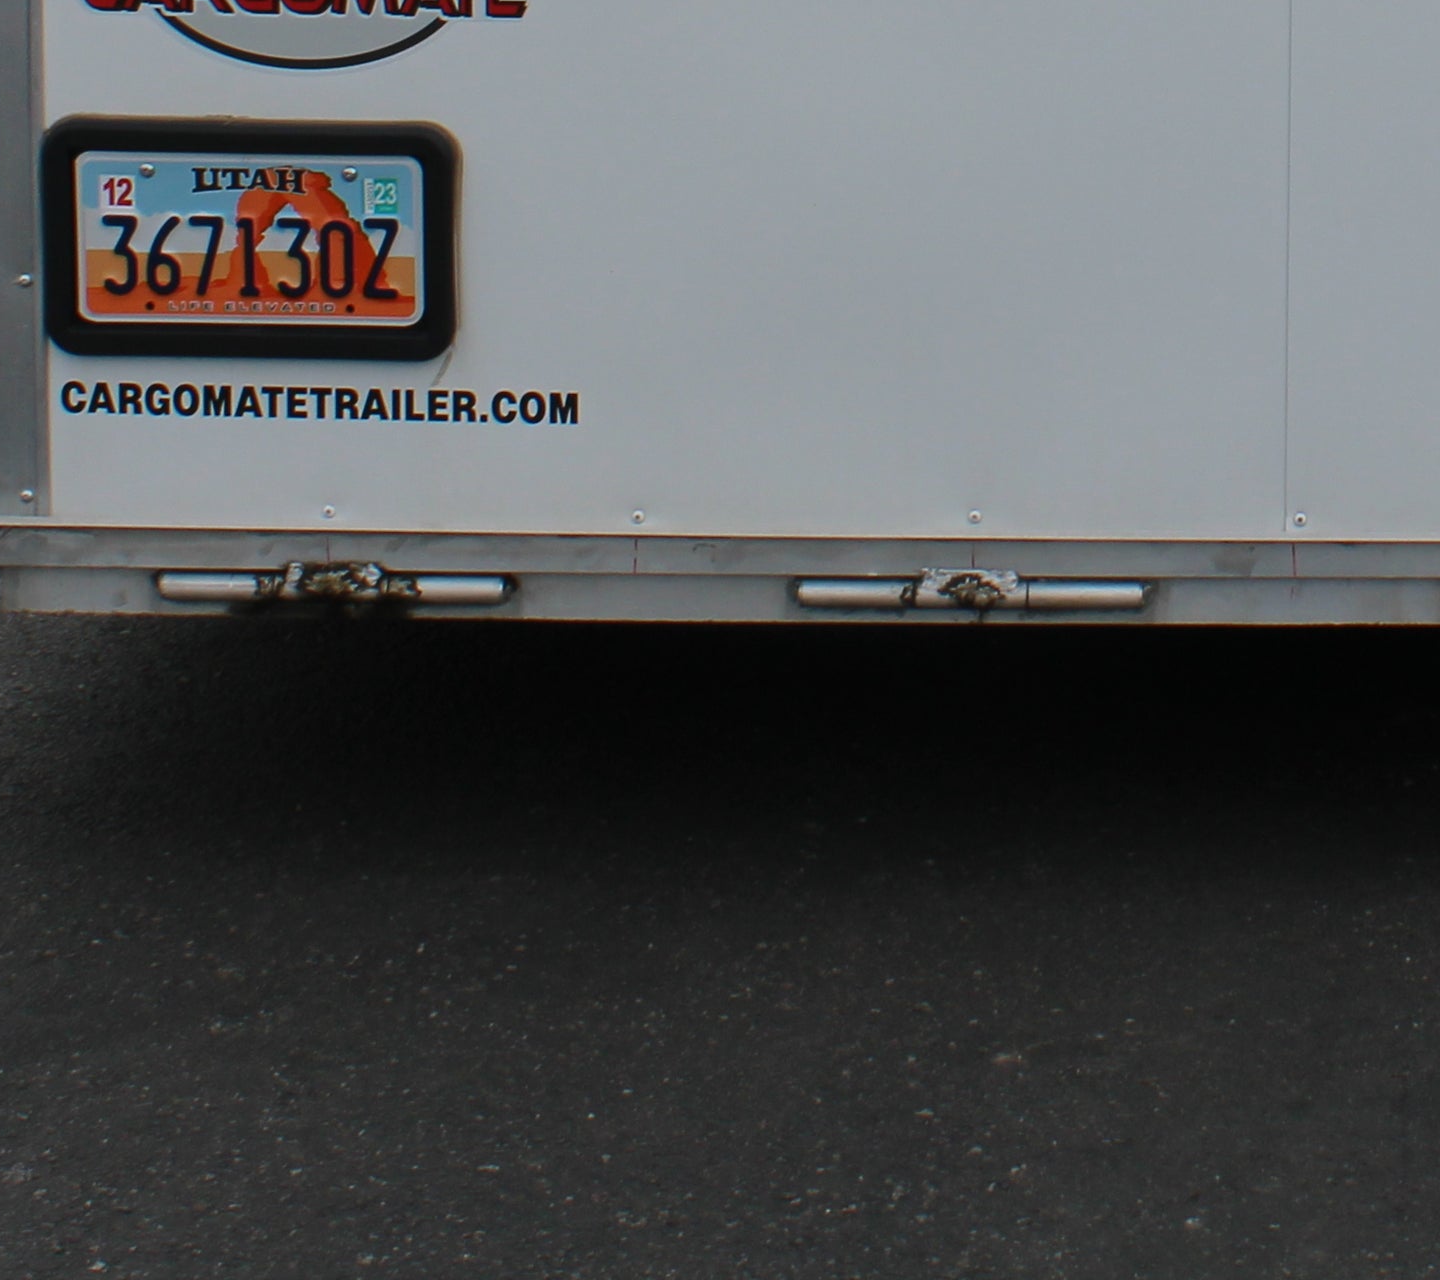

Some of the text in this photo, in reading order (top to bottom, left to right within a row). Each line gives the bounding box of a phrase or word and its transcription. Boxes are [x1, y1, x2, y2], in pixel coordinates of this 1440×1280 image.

[102, 178, 134, 207] 12
[191, 167, 308, 194] UTAH
[374, 182, 399, 206] 23
[101, 214, 401, 299] 367130Z
[167, 300, 337, 313] LIFE ELEVATED
[60, 380, 580, 425] CARGOMATETRAILER.COM
